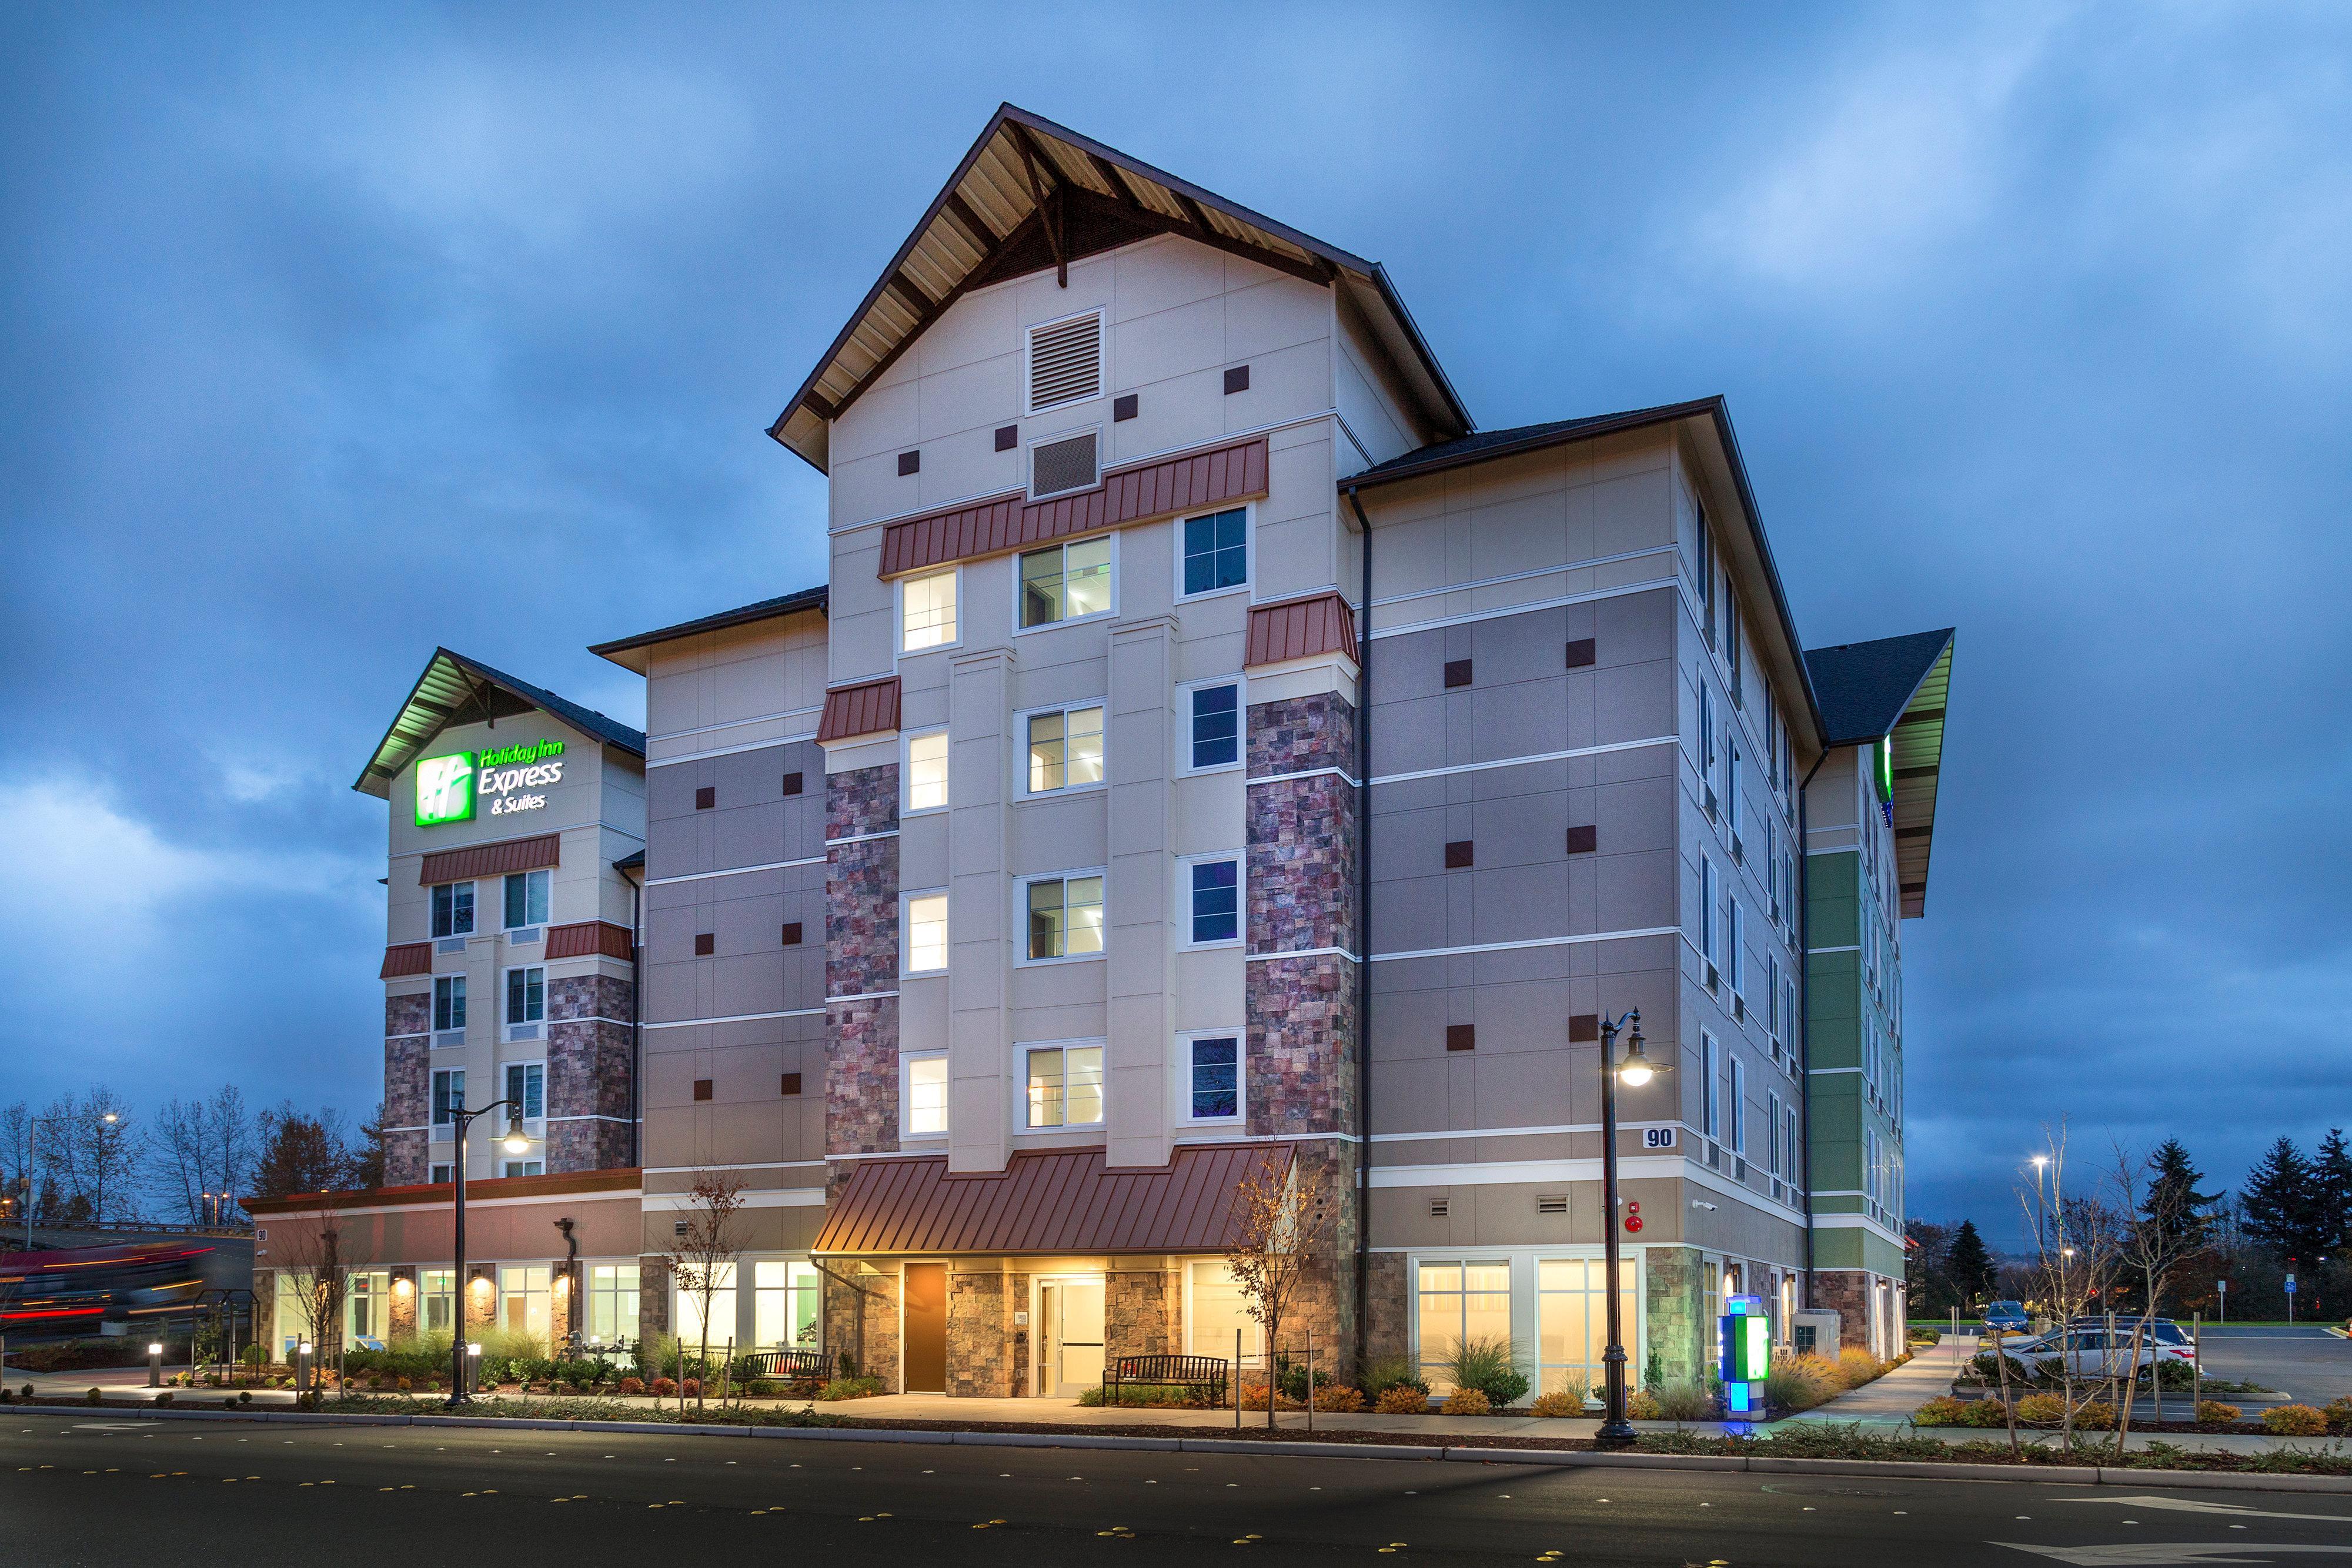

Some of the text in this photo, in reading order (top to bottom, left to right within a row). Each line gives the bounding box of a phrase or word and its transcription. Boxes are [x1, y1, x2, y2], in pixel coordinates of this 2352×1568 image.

[479, 738, 564, 768] Holiday Inn
[479, 762, 563, 797] Express
[492, 794, 546, 815] & Suites
[1648, 1128, 1672, 1147] 90
[259, 1230, 266, 1240] 90
